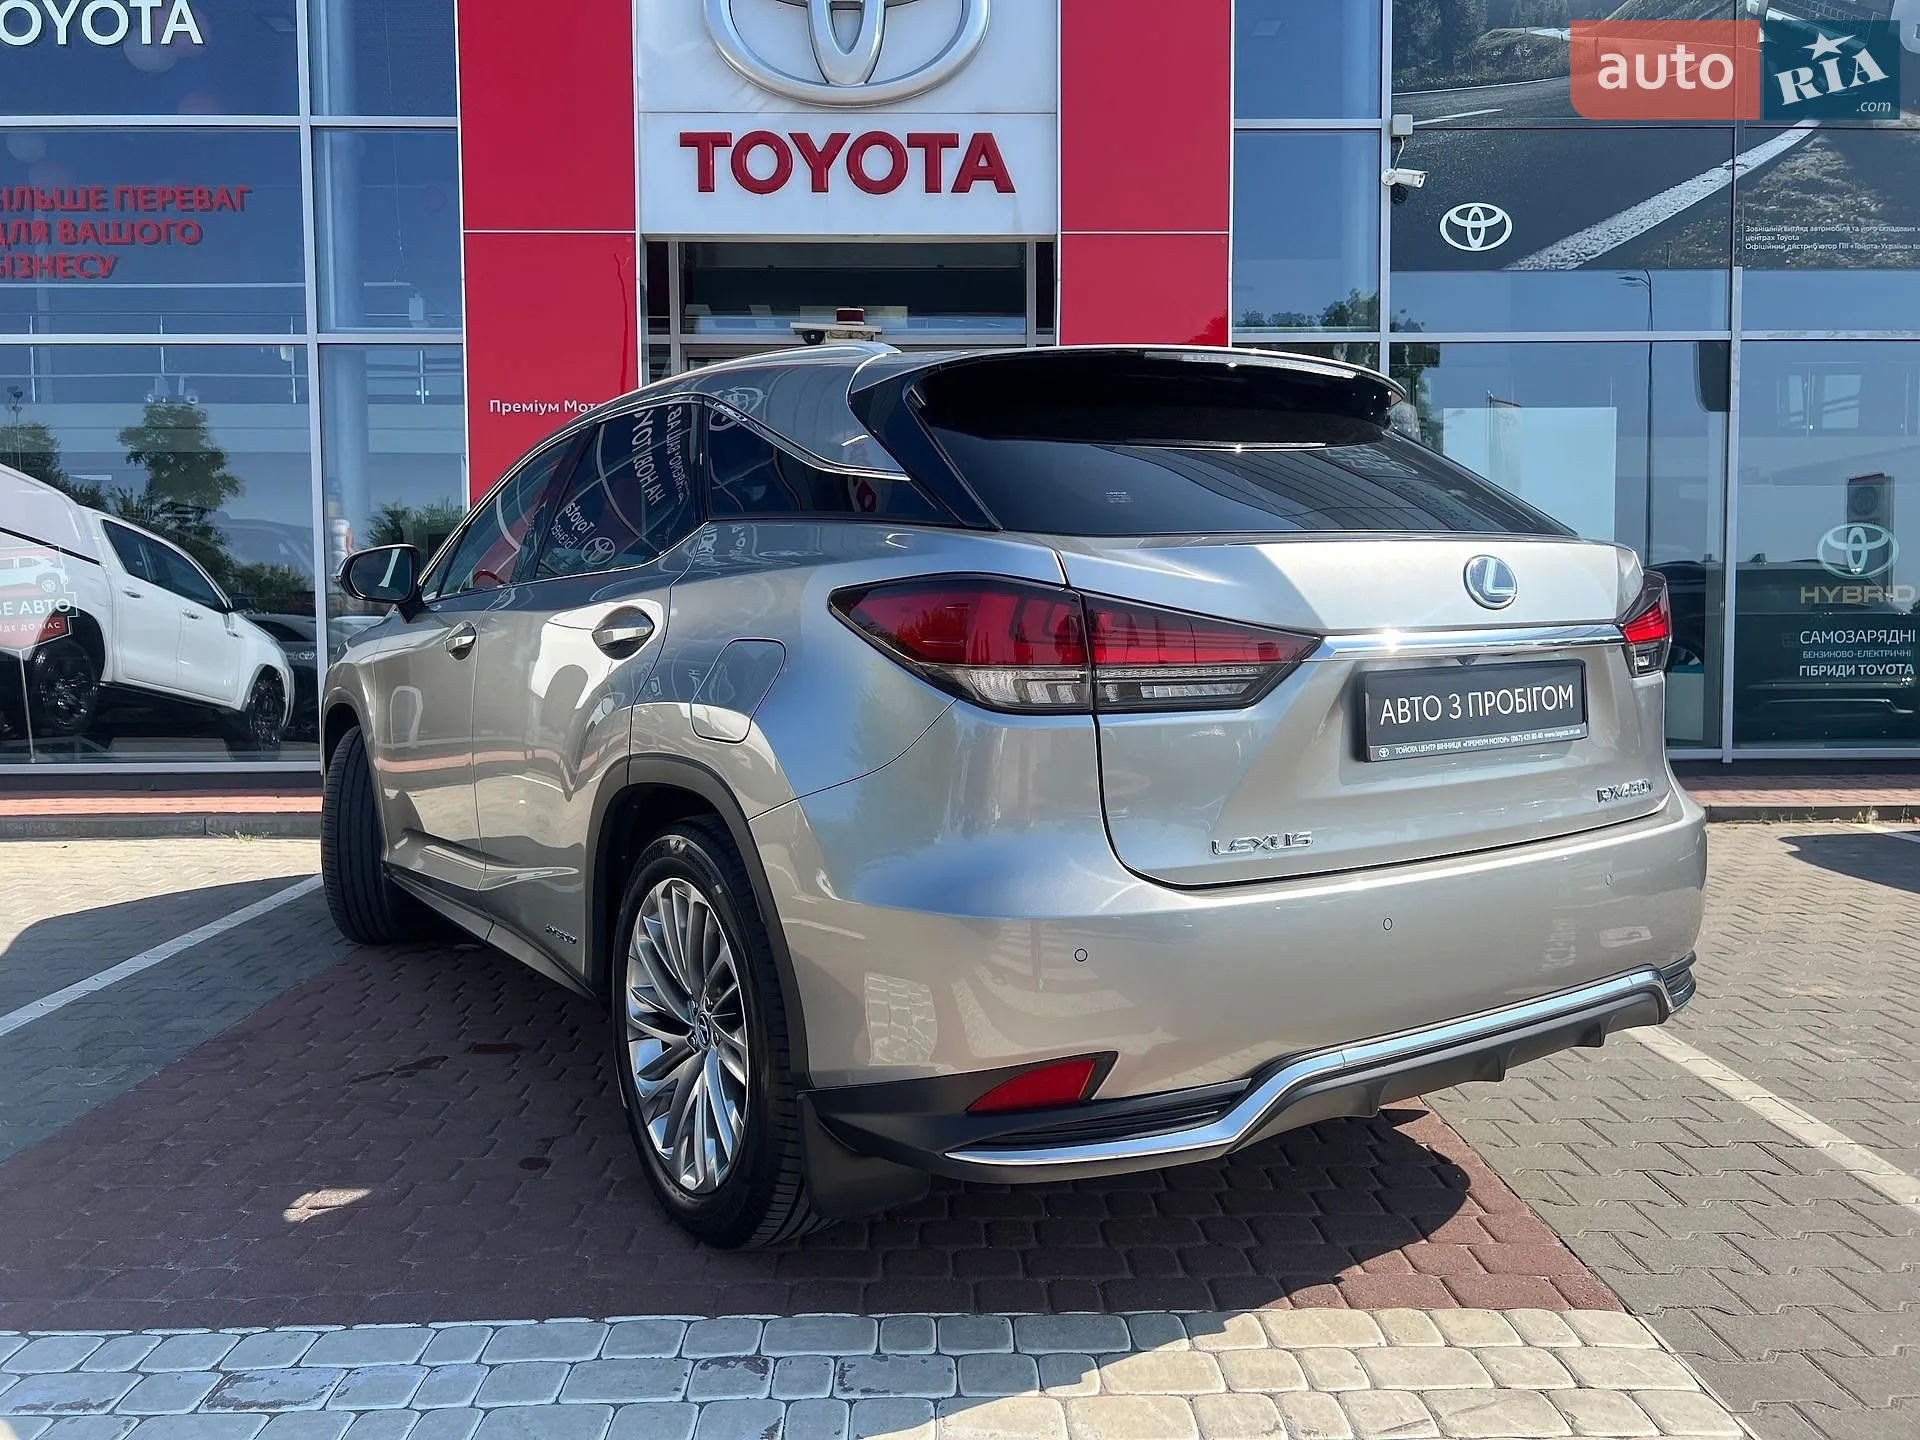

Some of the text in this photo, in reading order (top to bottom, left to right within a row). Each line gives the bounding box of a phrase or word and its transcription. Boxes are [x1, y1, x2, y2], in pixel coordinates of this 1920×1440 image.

[680, 130, 1016, 195] TOYOTA
[113, 186, 251, 211] ПЕРЕВАГ
[57, 219, 203, 244] ВАШОГО
[1777, 234, 1800, 242] Toyota
[489, 399, 560, 416] Преміум
[1800, 584, 1916, 604] HYBRID
[19, 598, 71, 615] АВТО
[21, 623, 36, 632] ДО
[1800, 629, 1916, 645] САМОЗАРЯДНІ
[1802, 649, 1912, 659] БЕНЗИНОВО-ЕЛЕКТРИЧНІ
[1799, 663, 1915, 678] ГІБРИДИ TOYOTA
[1380, 694, 1442, 726] АВТО
[1468, 684, 1574, 718] ПРОБІГОМ
[1211, 830, 1313, 855] LEXUS
